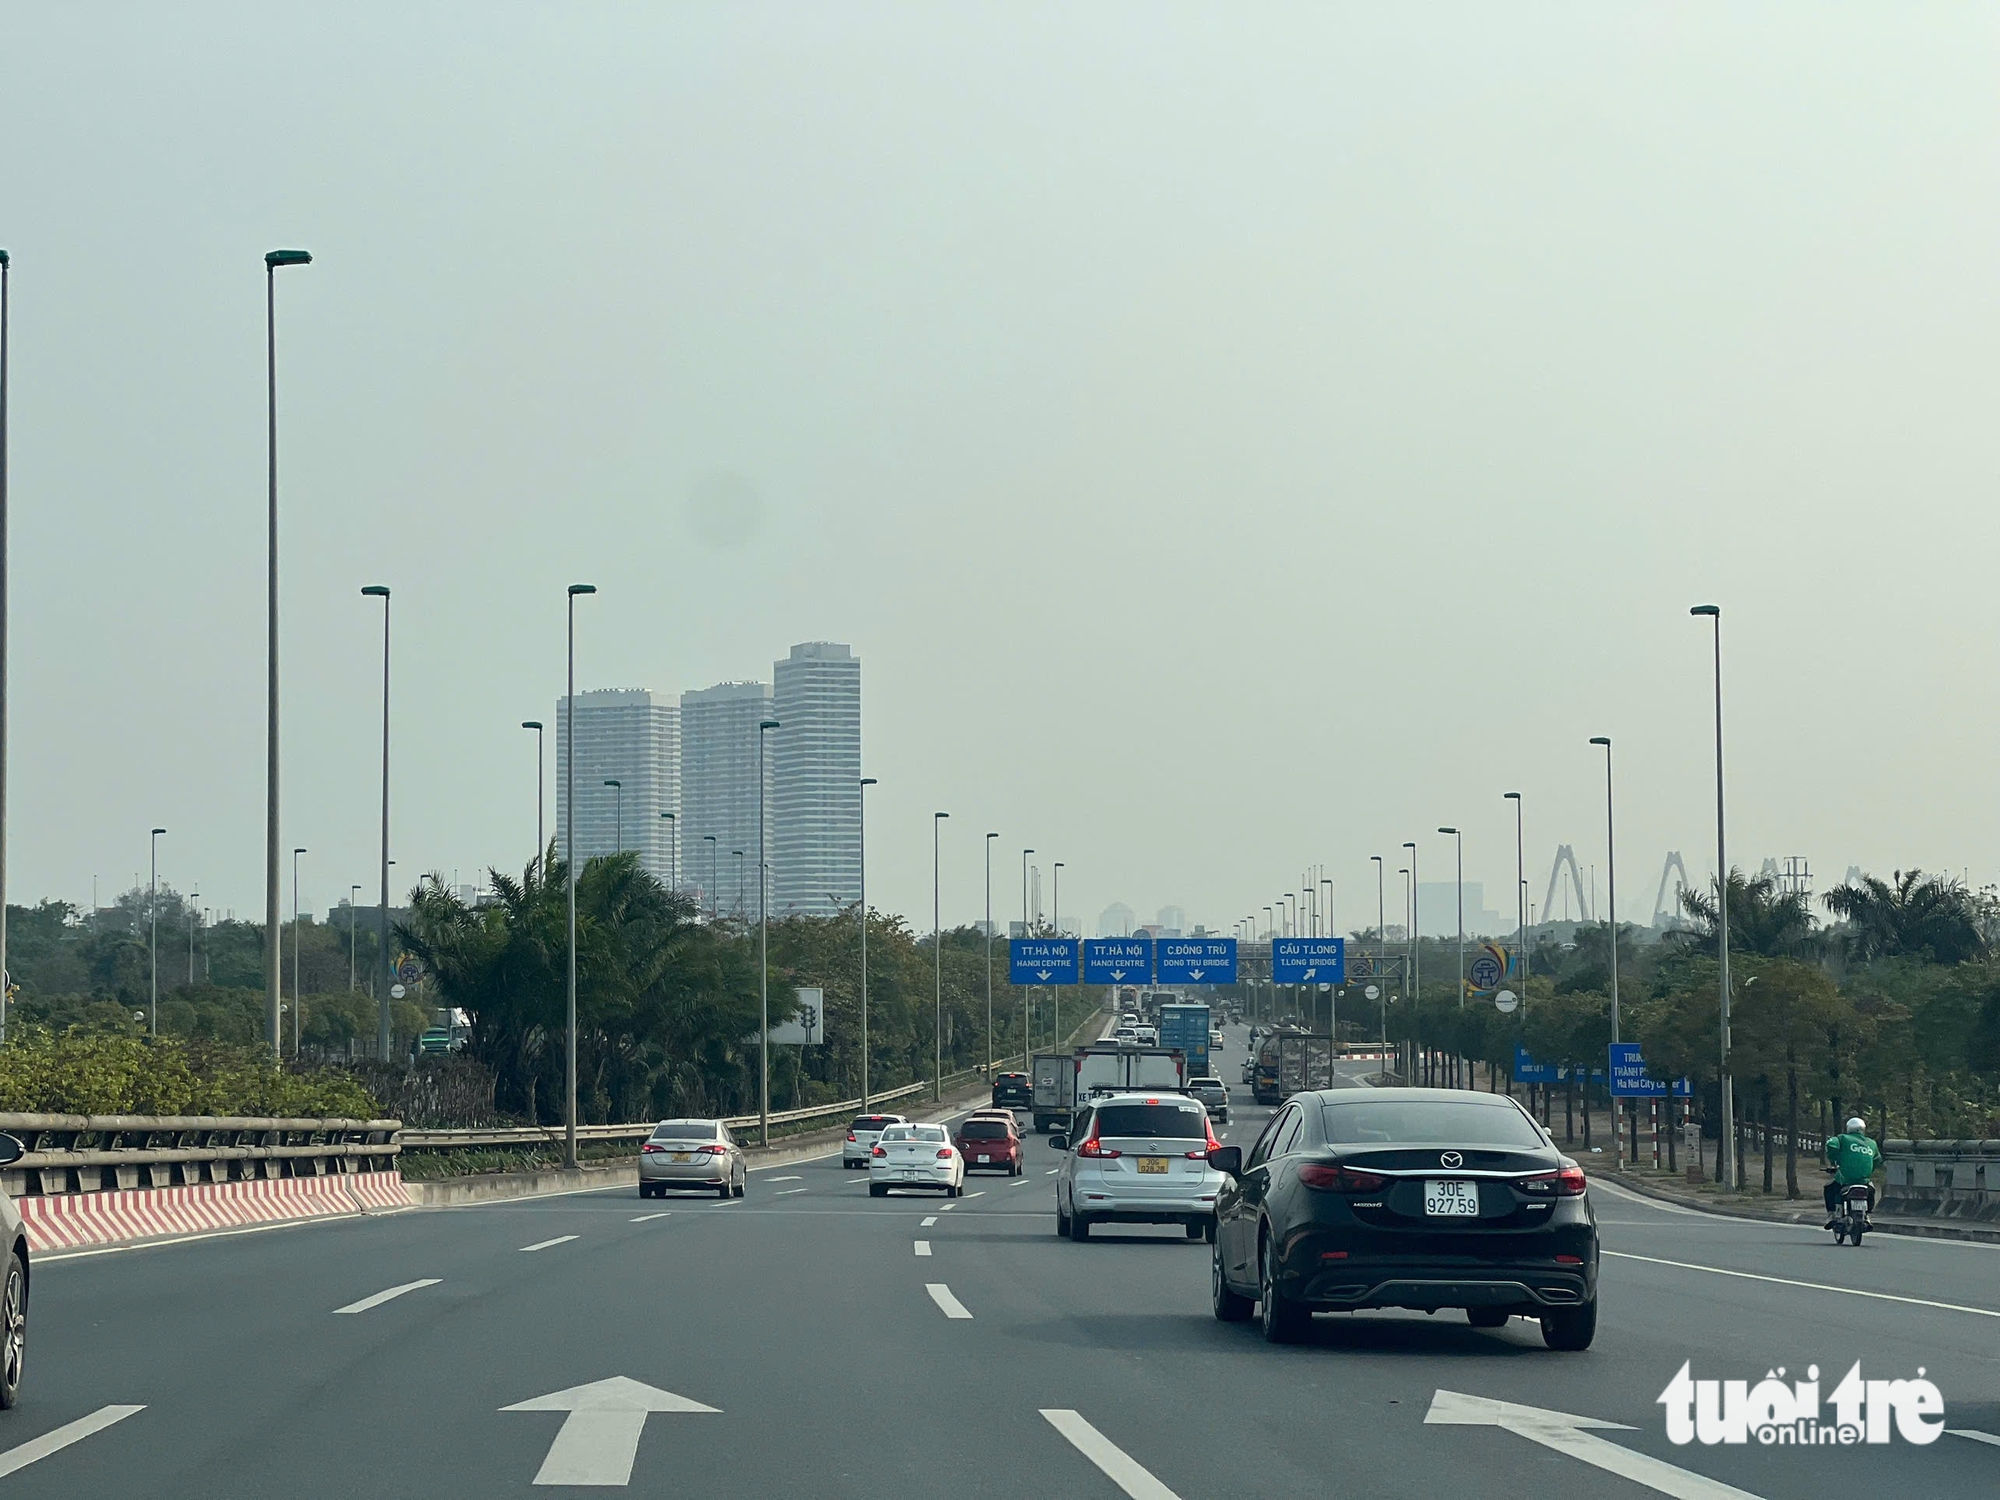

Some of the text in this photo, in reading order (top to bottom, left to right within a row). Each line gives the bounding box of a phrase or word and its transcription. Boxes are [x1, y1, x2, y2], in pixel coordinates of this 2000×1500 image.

[1303, 945, 1337, 955] T.LONG
[1016, 959, 1072, 967] HANOI CENTRE
[1090, 959, 1145, 967] HANOI CENTRE
[1163, 959, 1230, 967] DONG TRU BRIDGE
[1280, 958, 1337, 966] T.LONG BRIDGE
[1617, 1079, 1627, 1088] Ha
[1640, 1079, 1655, 1091] City
[1078, 1093, 1087, 1102] XE
[1850, 1143, 1873, 1156] Grab
[1437, 1181, 1465, 1197] 30E
[1427, 1197, 1476, 1214] 927.59
